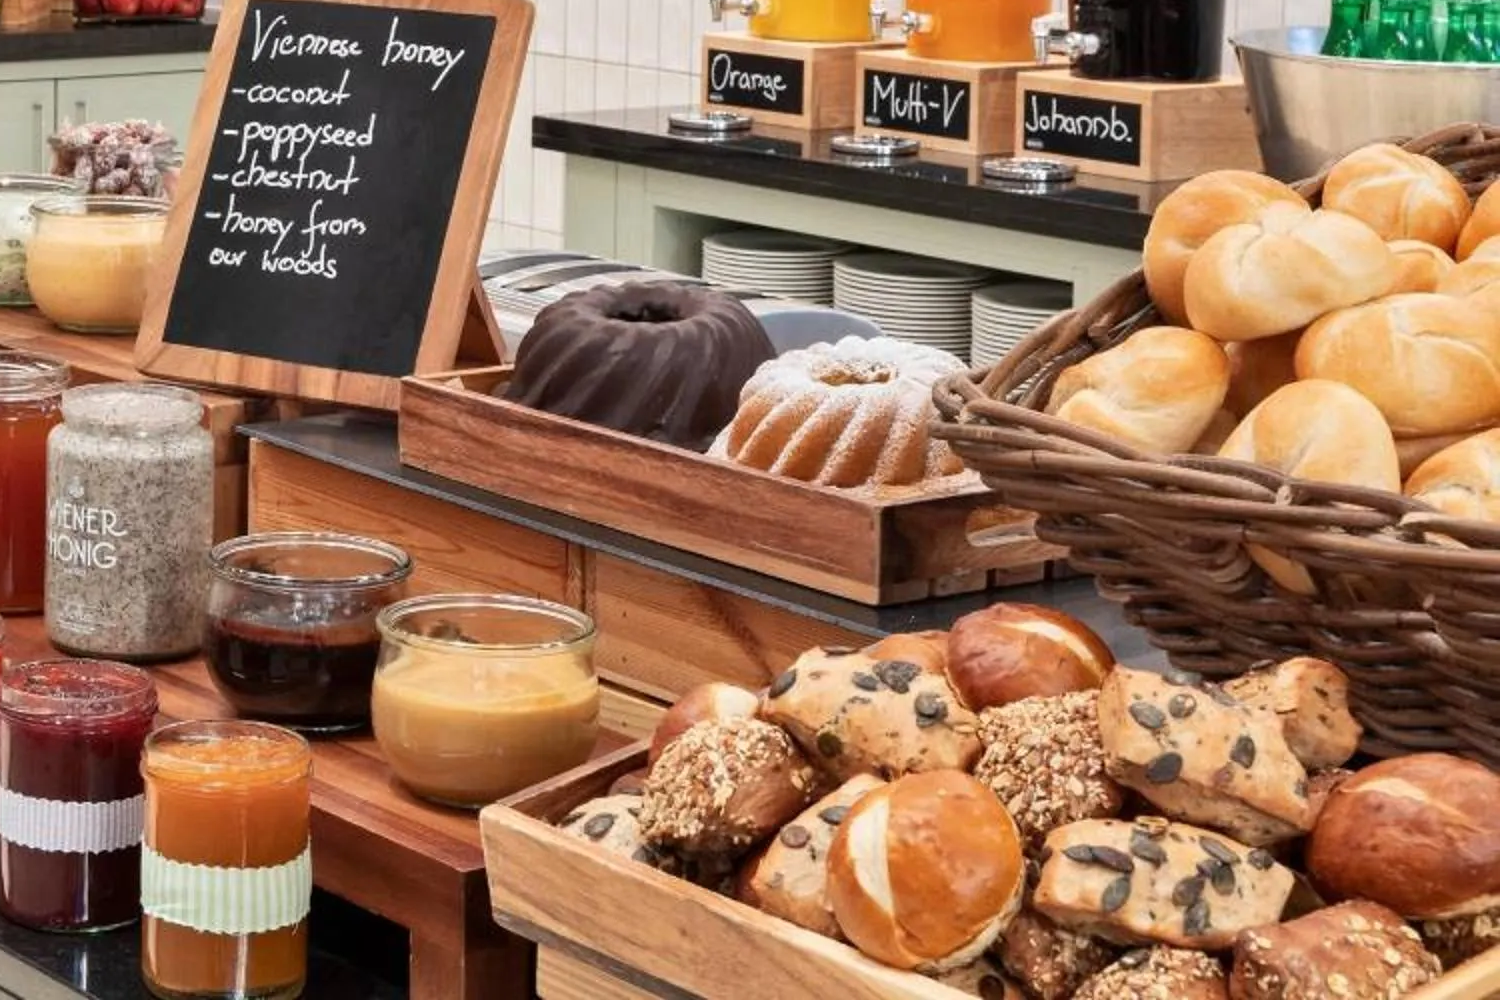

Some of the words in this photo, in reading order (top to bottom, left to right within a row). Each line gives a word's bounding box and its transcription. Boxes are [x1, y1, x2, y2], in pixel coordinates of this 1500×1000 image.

[251, 9, 362, 62] Viennese
[381, 16, 466, 91] honey
[711, 53, 787, 102] Orange
[300, 199, 367, 258] from
[209, 247, 247, 266] our
[261, 243, 337, 279] woods
[49, 531, 118, 569] HONIG
